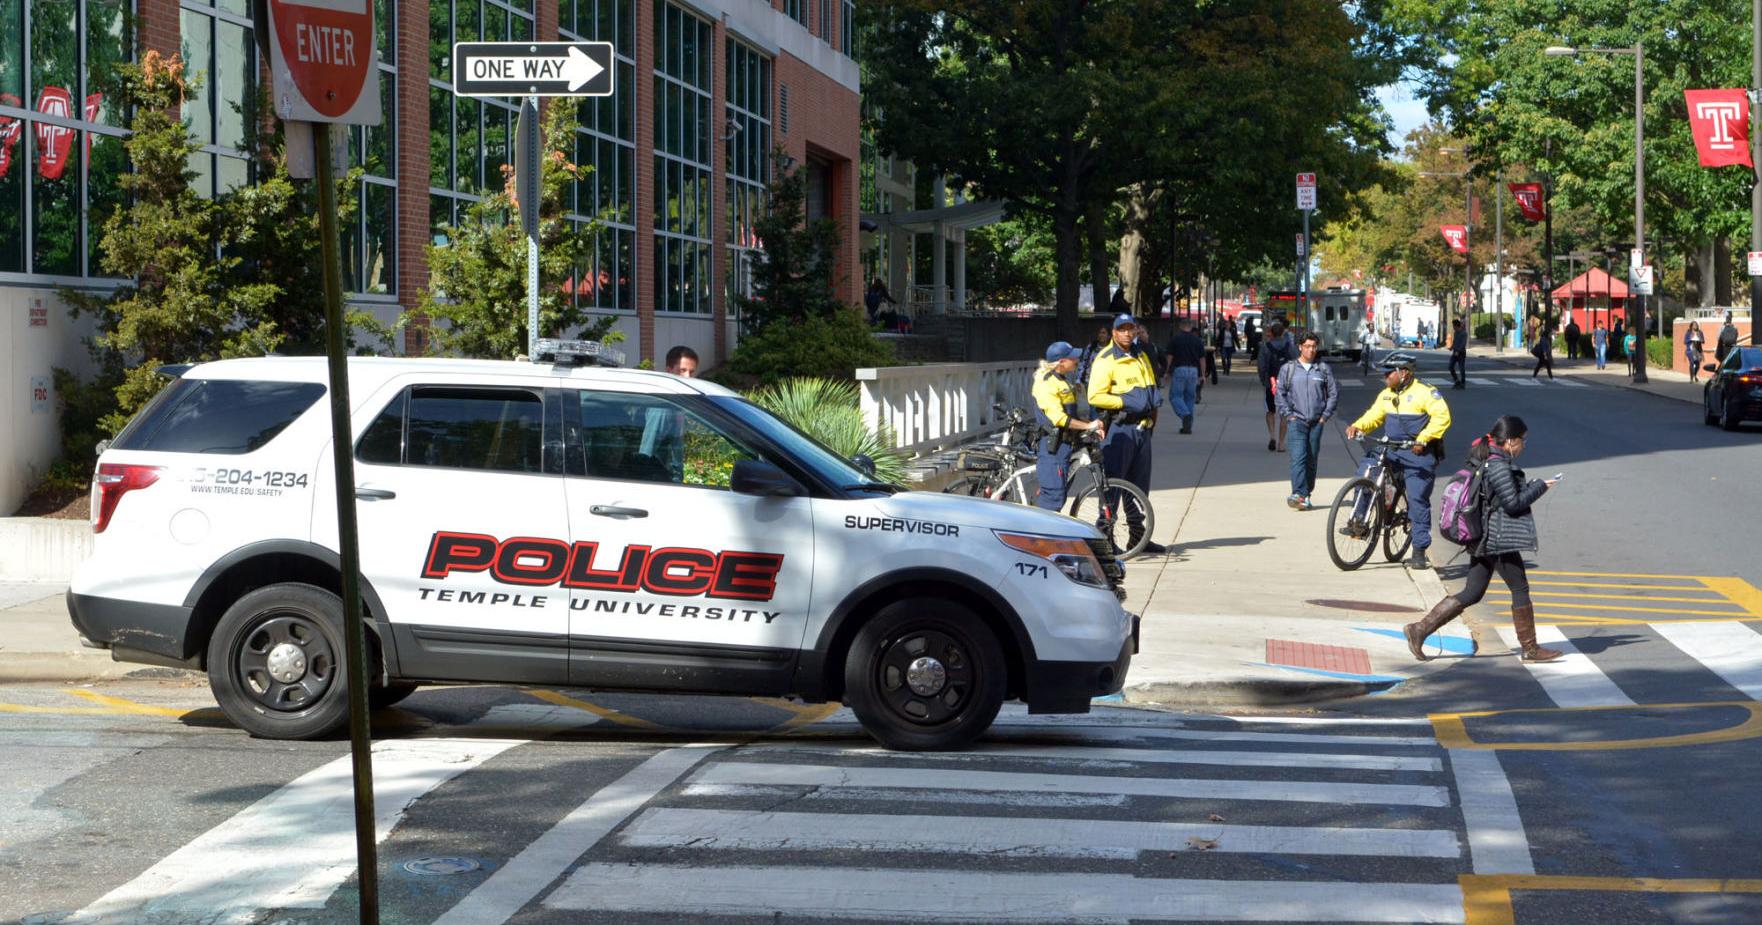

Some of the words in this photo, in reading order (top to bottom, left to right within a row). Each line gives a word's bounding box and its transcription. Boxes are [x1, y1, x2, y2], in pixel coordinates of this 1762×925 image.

[296, 23, 356, 67] ENTER
[473, 59, 515, 79] ONE
[523, 59, 566, 78] WAY
[1696, 102, 1741, 149] T
[34, 388, 48, 401] FDC
[844, 515, 960, 538] SUPERVISOR
[420, 530, 785, 602] POLICE
[1015, 562, 1048, 579] 171
[418, 588, 549, 608] TEMPLE
[569, 598, 781, 624] UNIVERSITY
